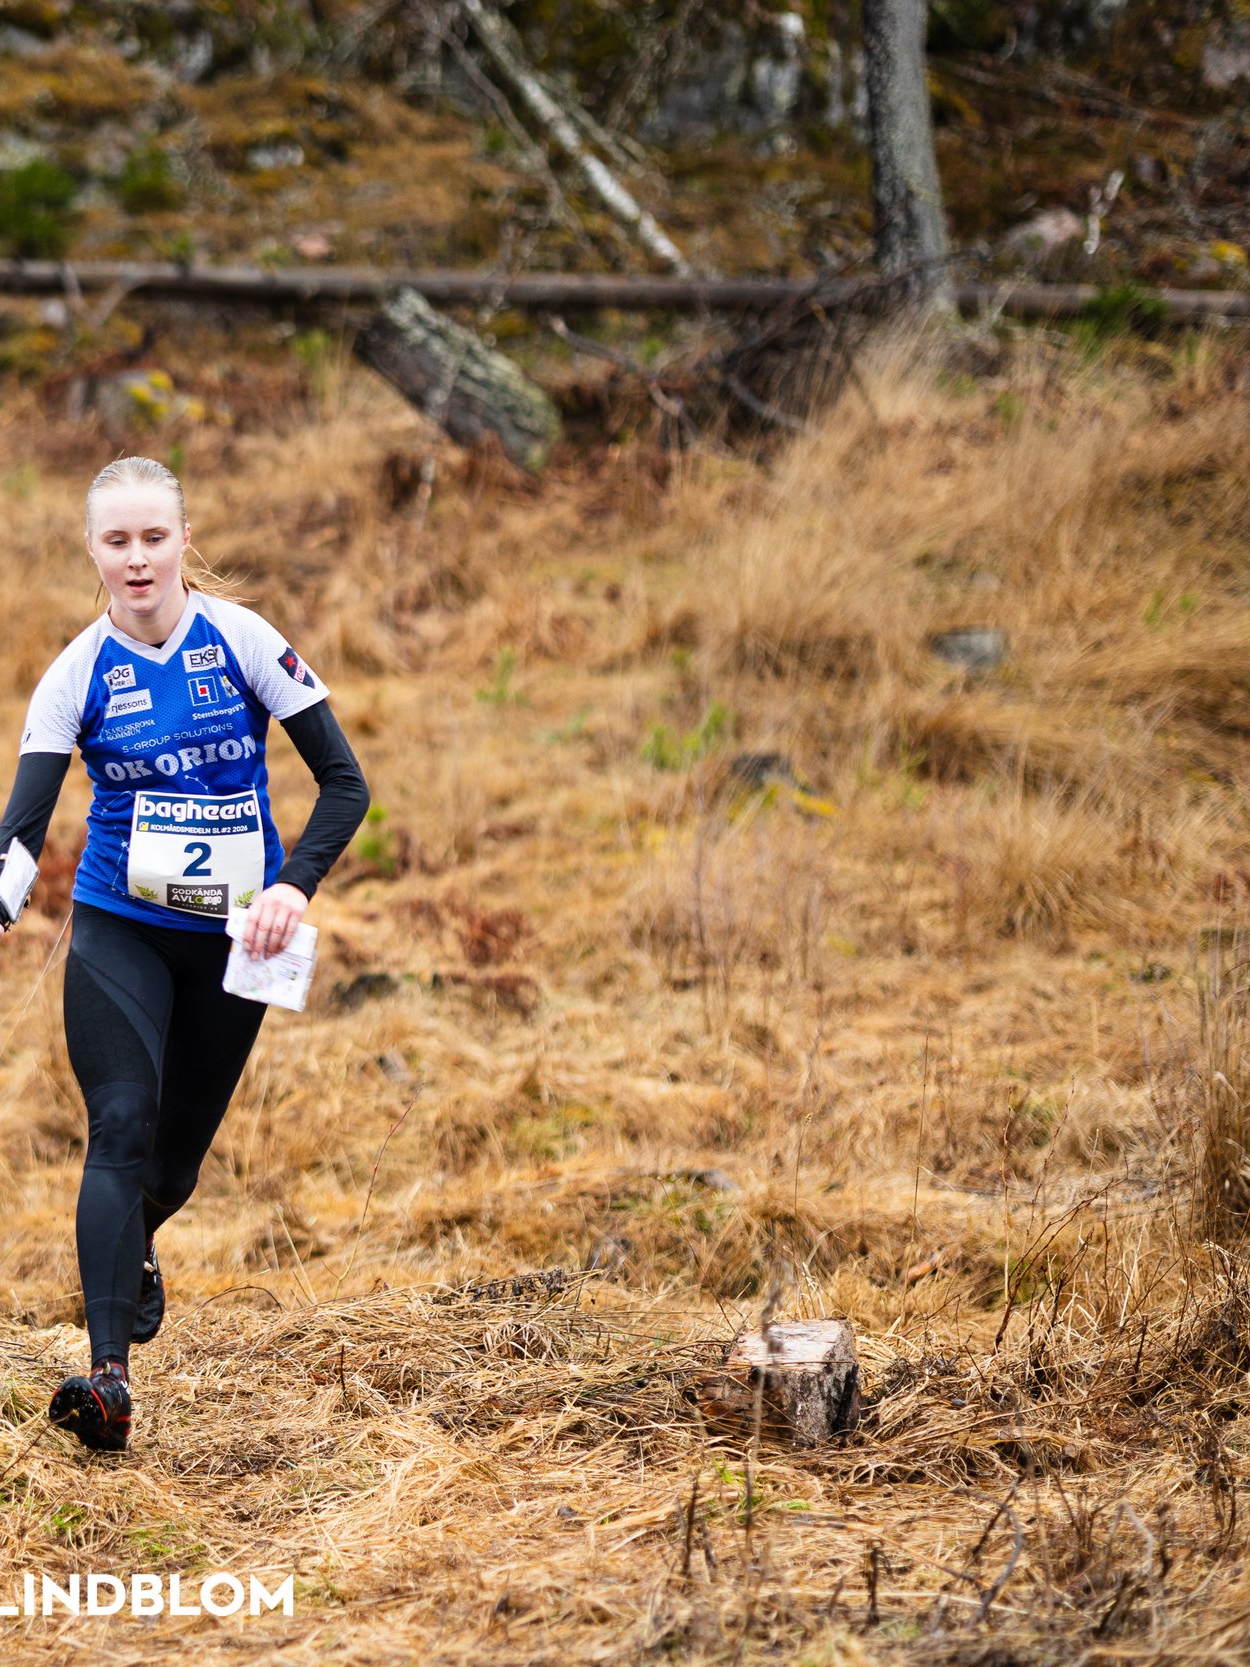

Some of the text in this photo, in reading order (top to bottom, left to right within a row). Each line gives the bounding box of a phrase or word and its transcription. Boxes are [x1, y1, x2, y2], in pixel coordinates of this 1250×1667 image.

[122, 735, 171, 753] S-GROUP
[174, 722, 234, 741] SOLUTIONS
[104, 735, 257, 782] OK ORION
[138, 796, 257, 822] bagheera
[182, 841, 212, 877] 2
[171, 887, 223, 896] GODKÄNDA
